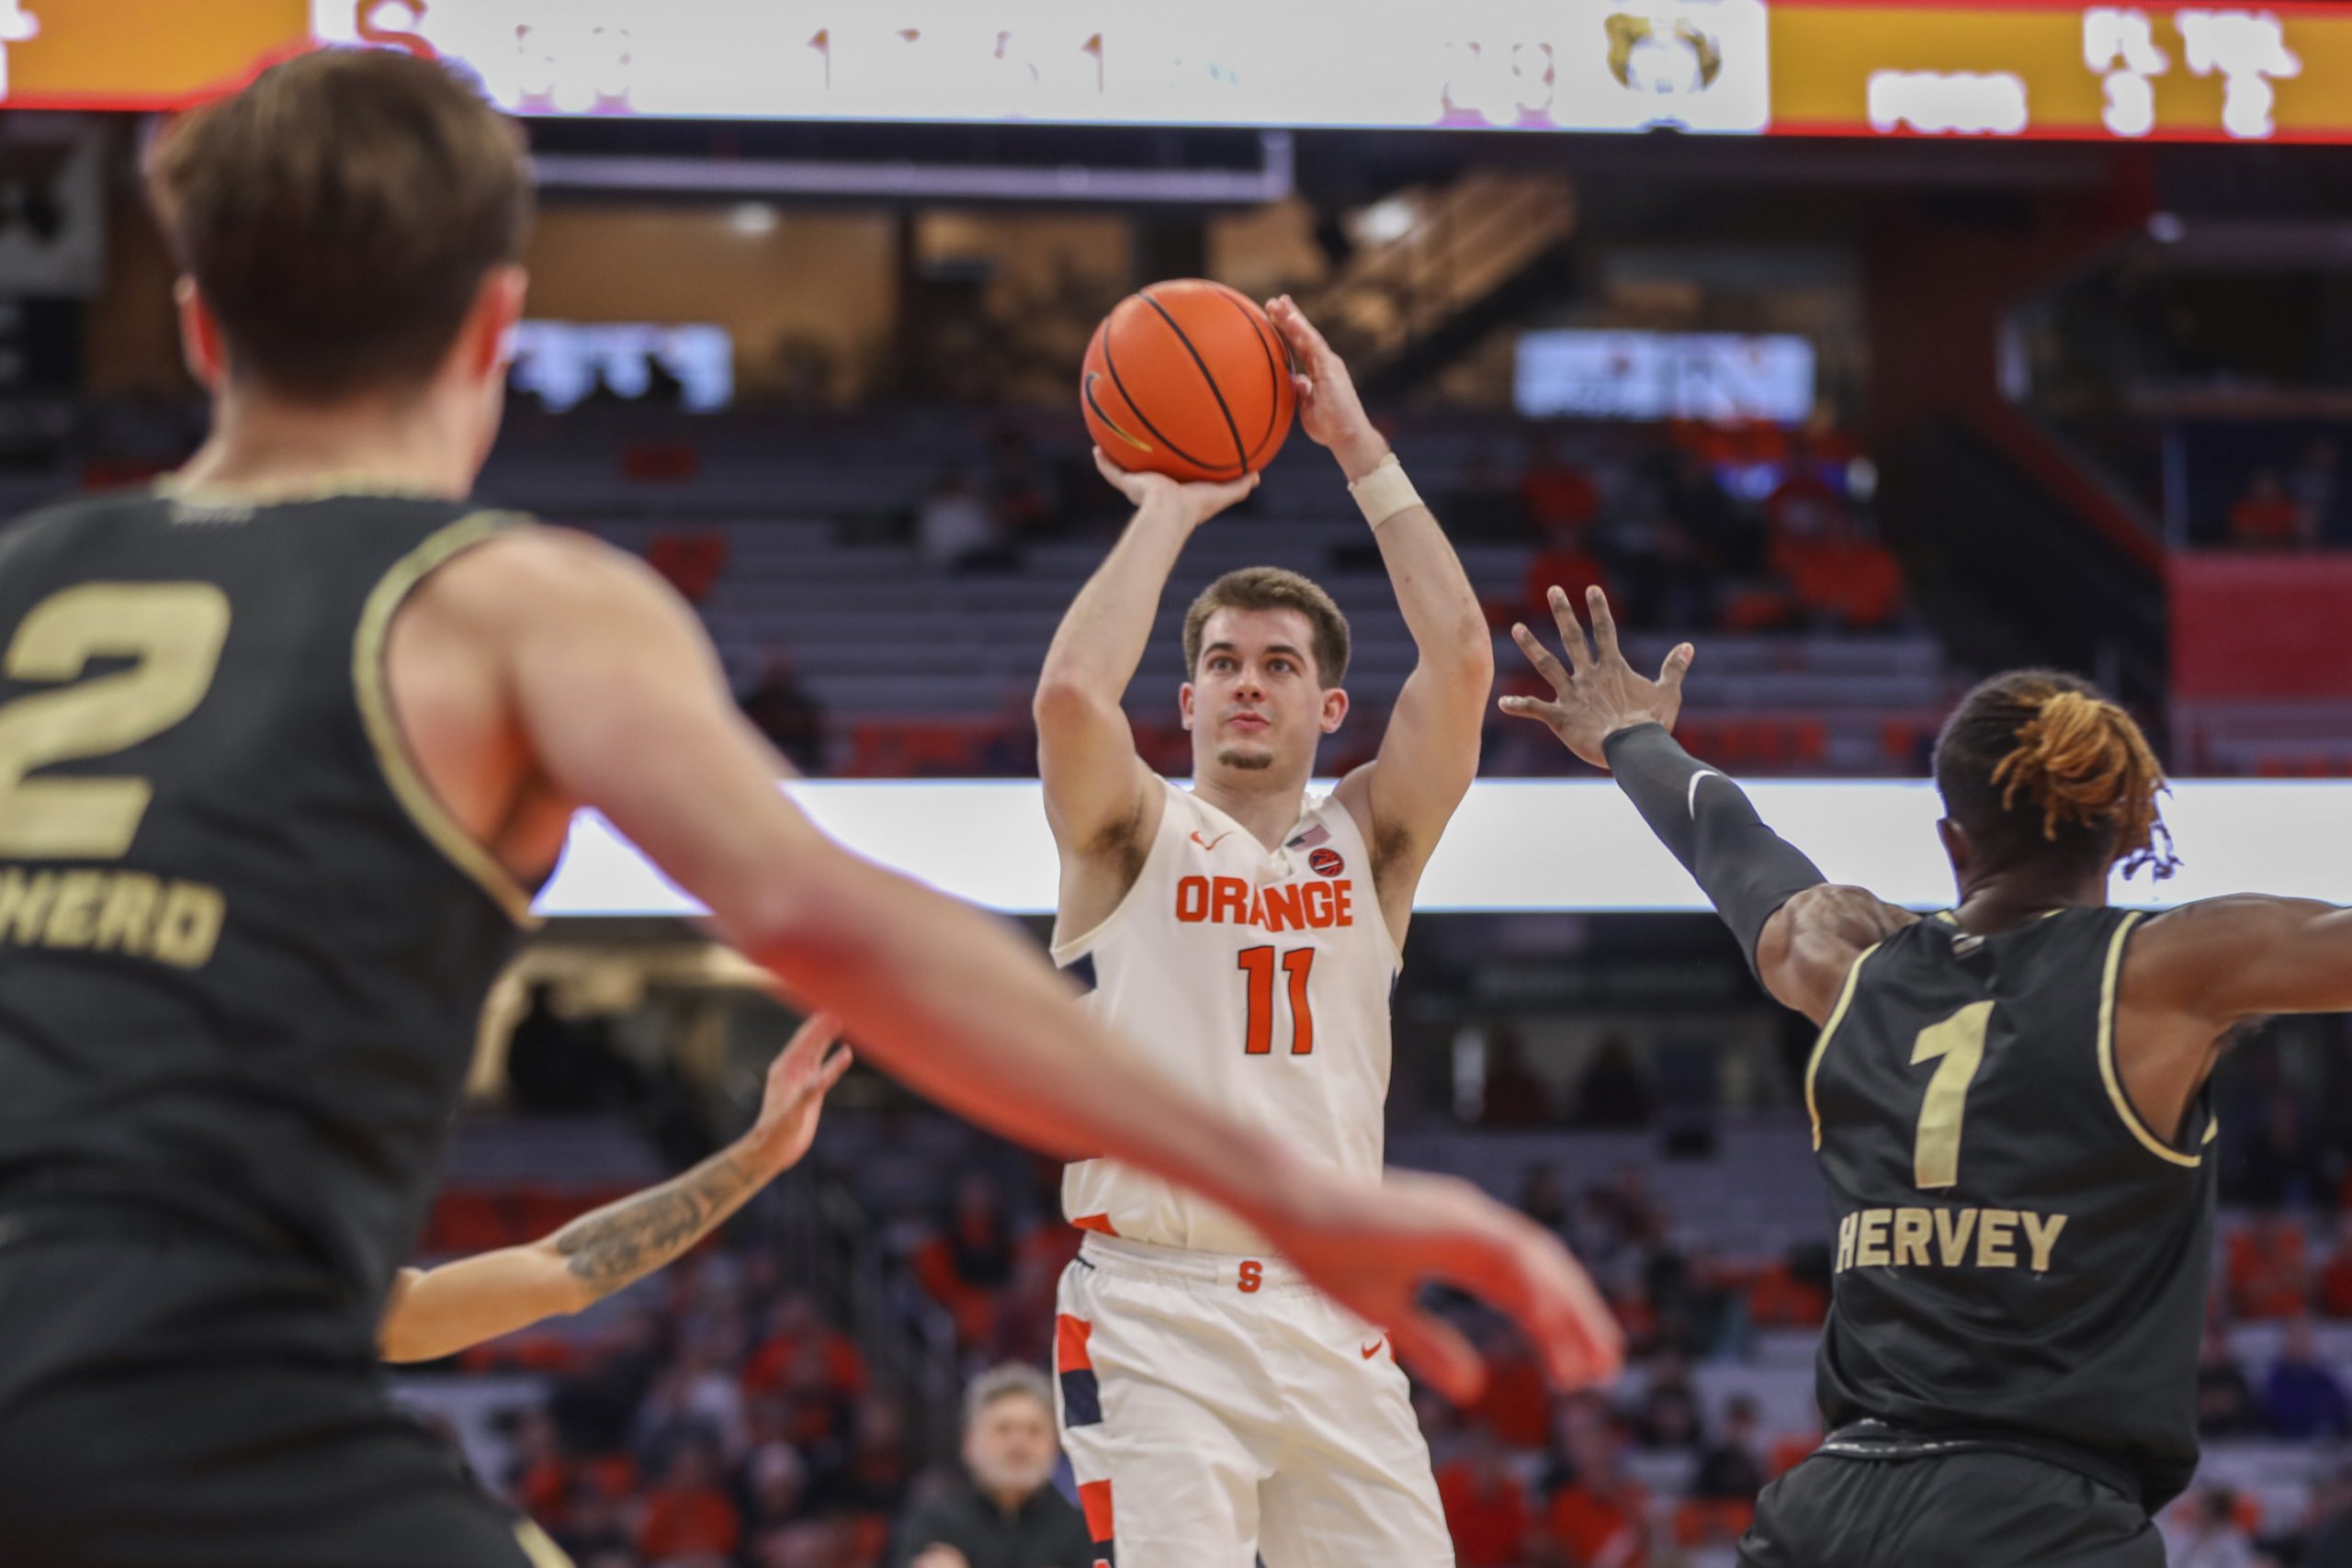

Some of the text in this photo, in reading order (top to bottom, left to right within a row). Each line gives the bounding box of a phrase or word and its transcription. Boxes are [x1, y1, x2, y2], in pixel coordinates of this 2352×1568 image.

[0, 581, 232, 861] 2
[1176, 875, 1353, 932] ORANGE
[1238, 945, 1316, 1055] 11
[1910, 999, 1996, 1190] 1
[1238, 1260, 1263, 1293] S
[1835, 1207, 2069, 1274] HERVEY
